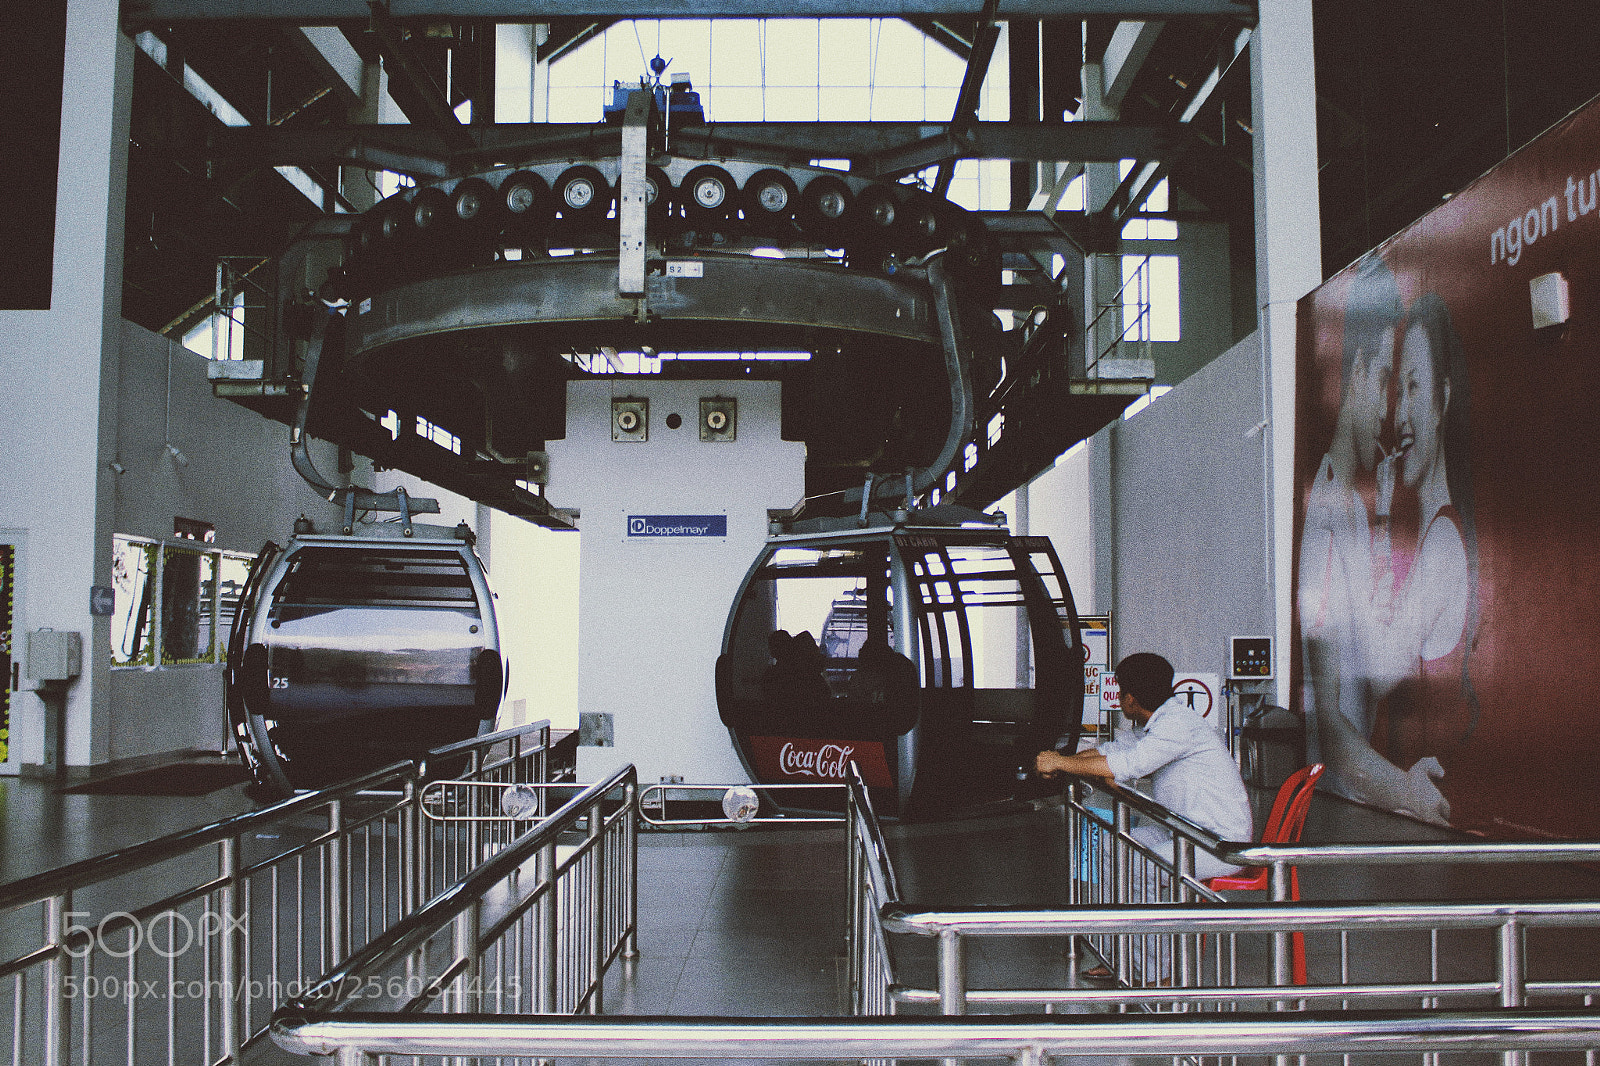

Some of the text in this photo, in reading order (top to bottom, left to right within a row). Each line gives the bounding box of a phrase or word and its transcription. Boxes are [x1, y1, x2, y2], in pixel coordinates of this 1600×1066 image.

[1491, 169, 1600, 266] ngon tu
[646, 525, 708, 535] Doppelmayr
[273, 677, 289, 689] 25
[780, 742, 854, 778] Coca-Col
